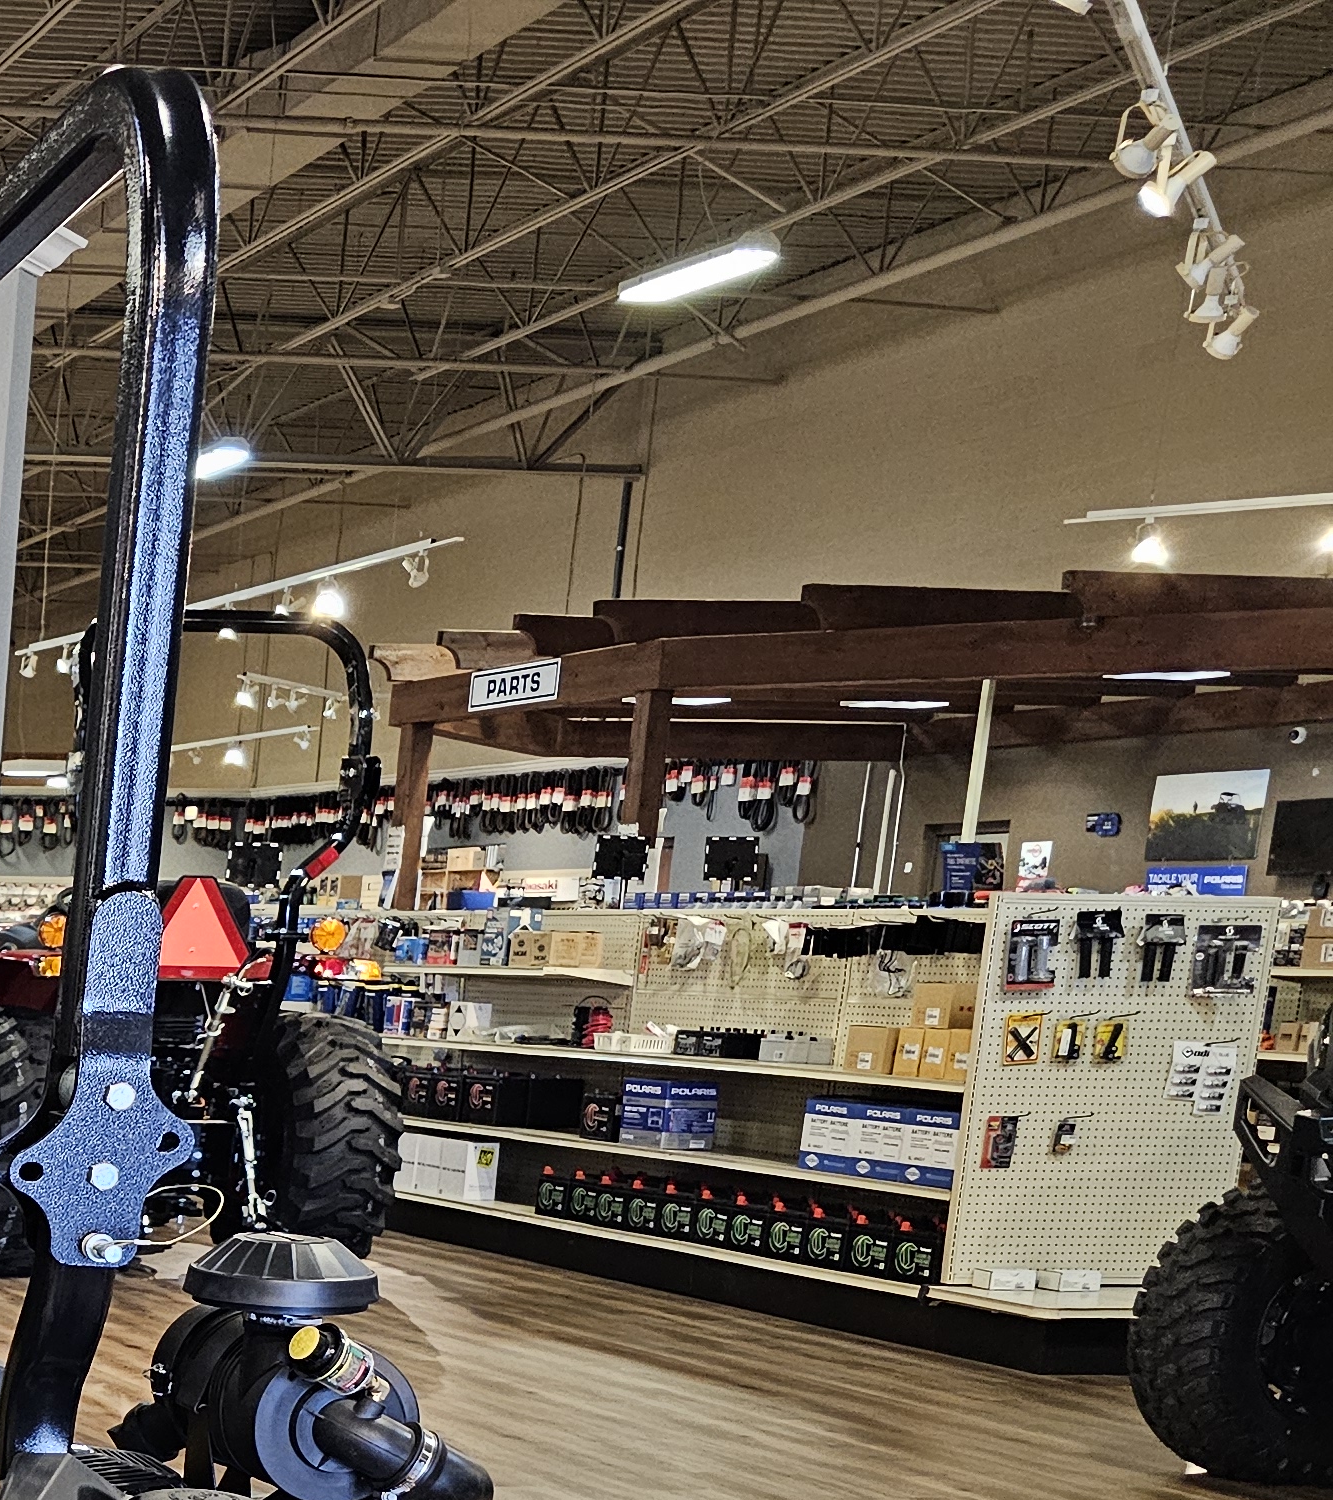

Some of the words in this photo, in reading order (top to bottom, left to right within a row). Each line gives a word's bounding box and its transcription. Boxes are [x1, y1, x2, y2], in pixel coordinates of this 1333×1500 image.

[487, 672, 540, 699] PARTS
[1149, 873, 1176, 884] TACKLE
[1020, 922, 1057, 930] SCOTT
[625, 1084, 661, 1094] POLARIS
[815, 1104, 847, 1114] POLARIS
[867, 1110, 901, 1119] POLARIS
[916, 1115, 952, 1125] POLARIS
